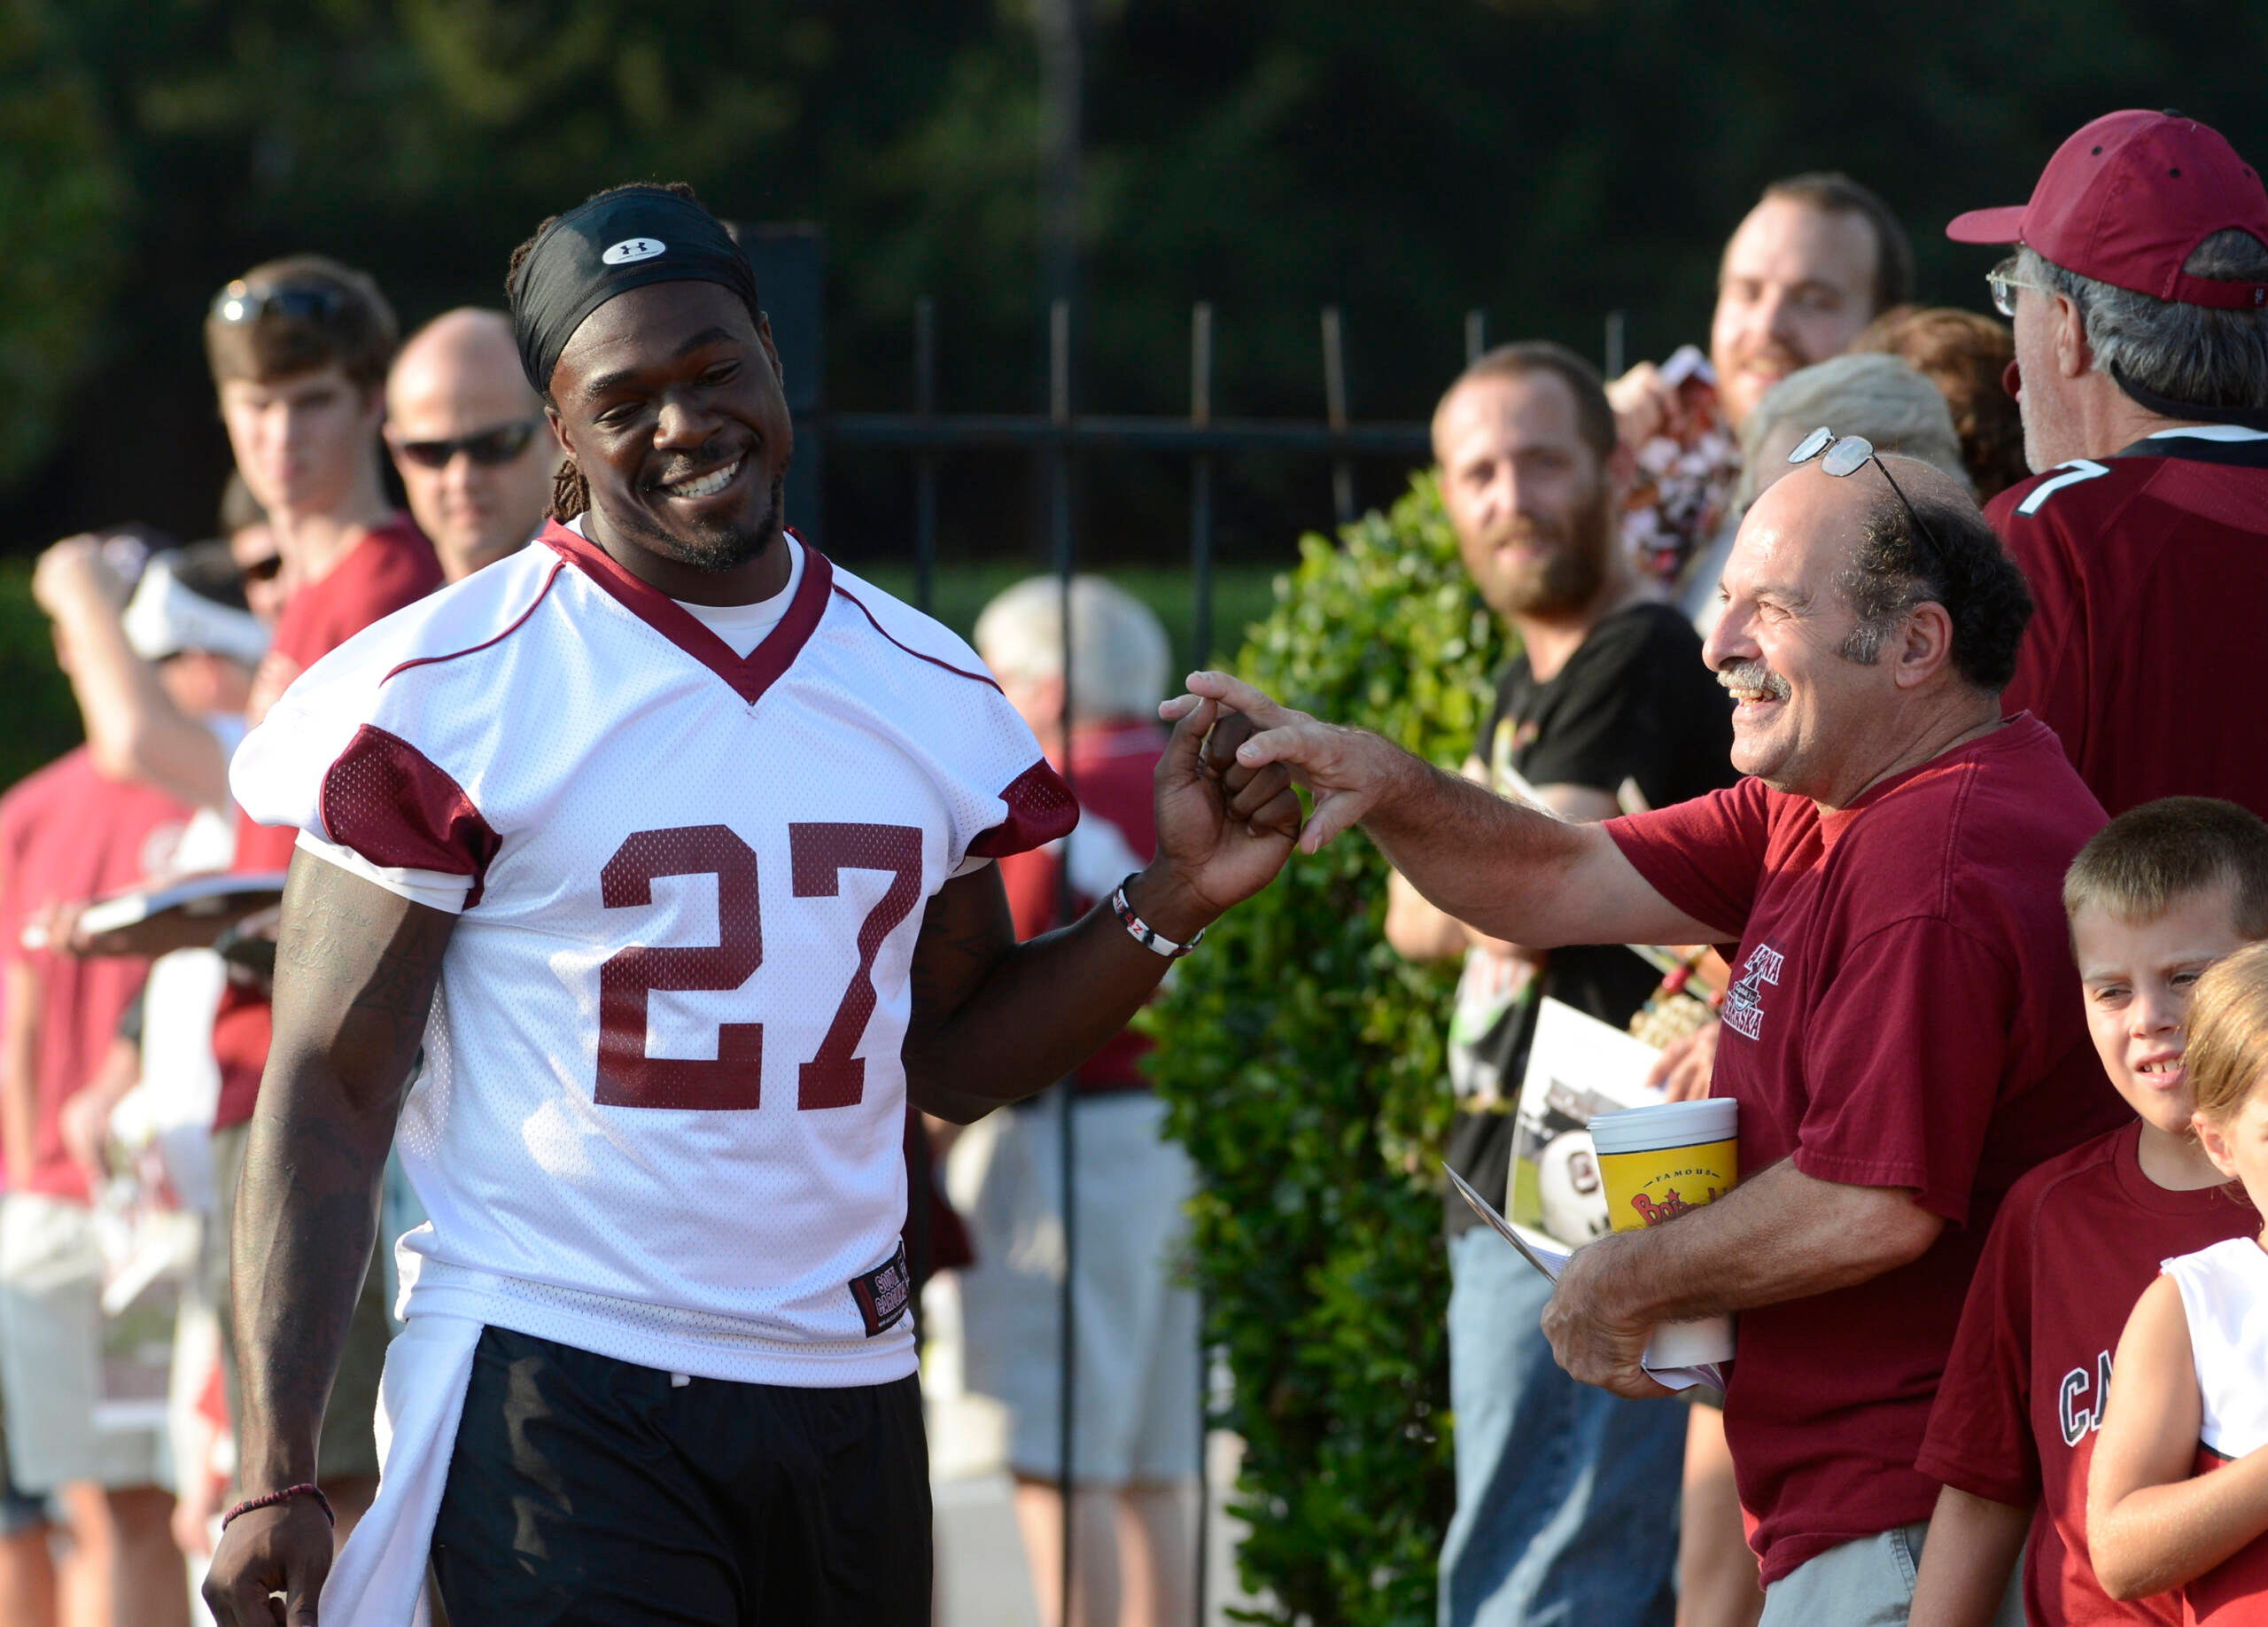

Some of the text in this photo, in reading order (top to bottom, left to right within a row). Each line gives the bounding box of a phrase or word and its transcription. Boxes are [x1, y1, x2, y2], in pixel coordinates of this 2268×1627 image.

[2014, 458, 2114, 518] 7
[594, 822, 922, 1111] 27
[1655, 1168, 1712, 1183] FAMOUS
